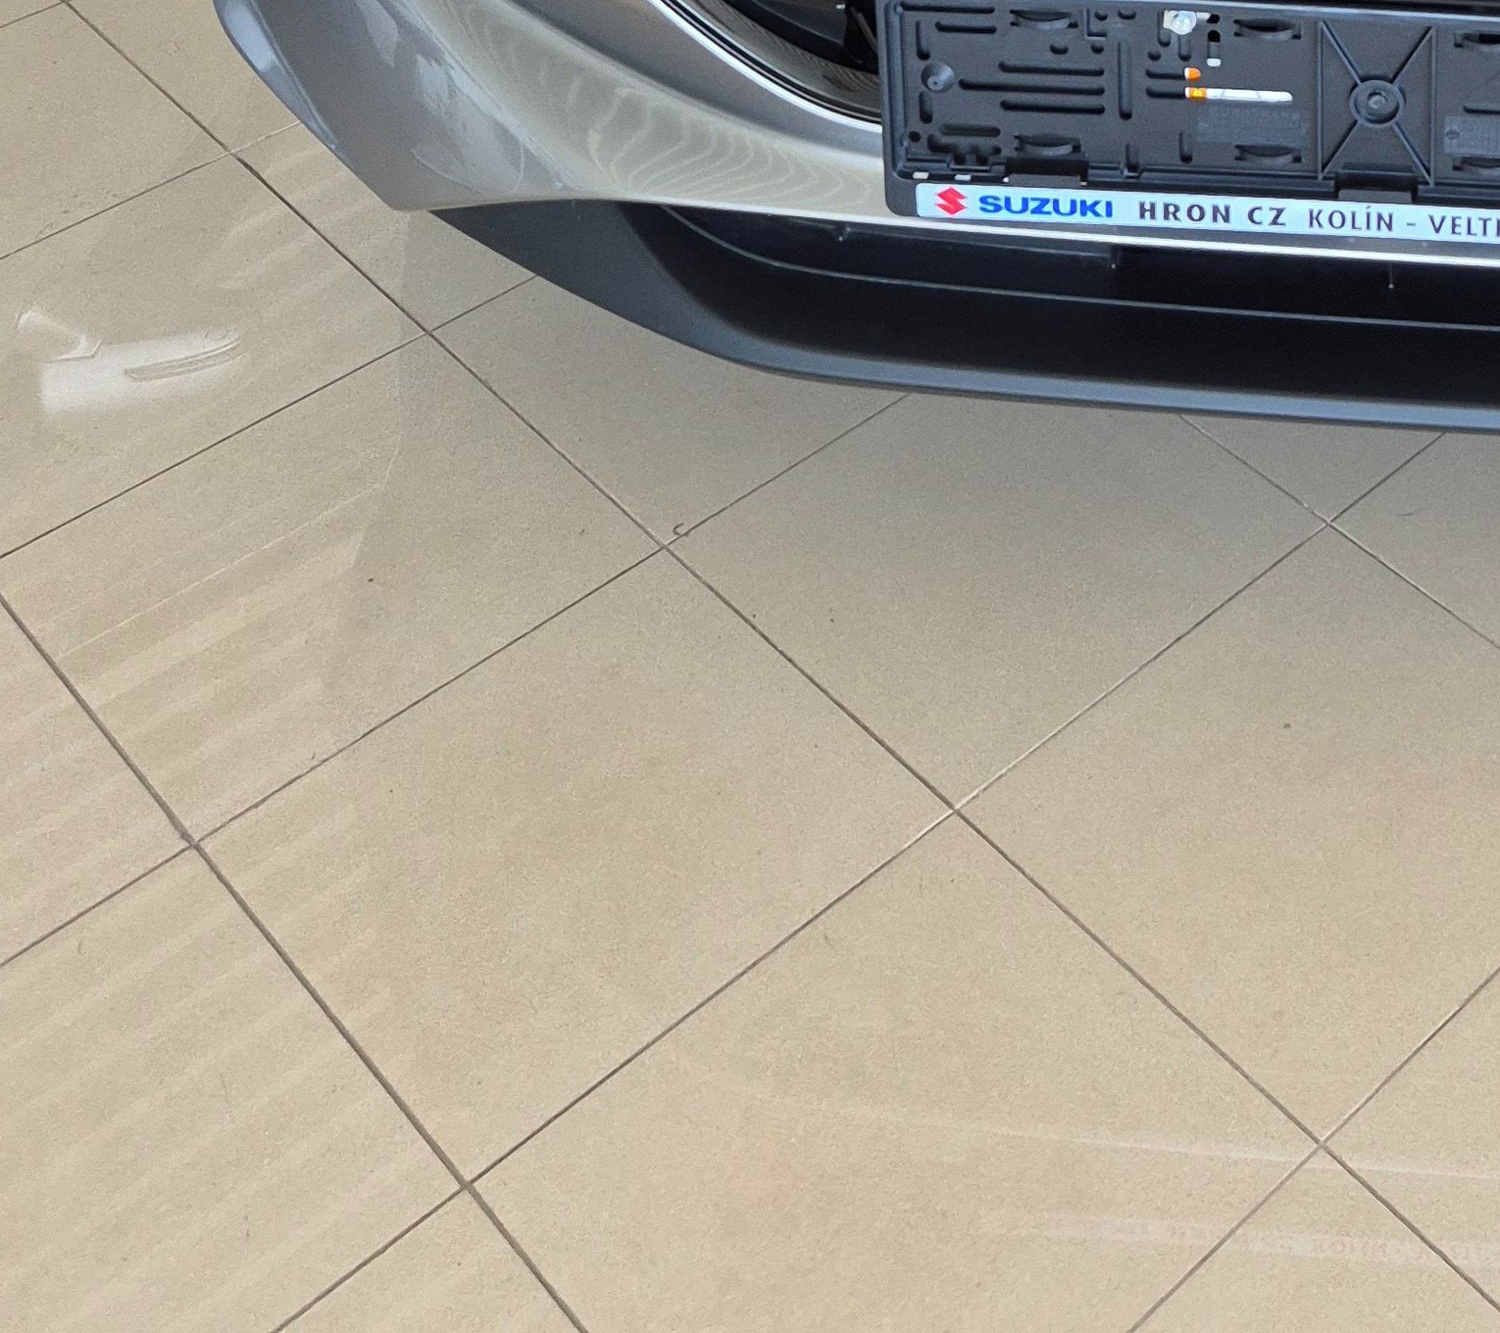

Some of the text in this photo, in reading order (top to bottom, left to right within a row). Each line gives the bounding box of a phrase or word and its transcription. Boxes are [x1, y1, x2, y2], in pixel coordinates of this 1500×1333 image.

[979, 195, 1113, 218] SUZUKI
[1138, 201, 1231, 224] HRON
[1247, 206, 1287, 227] CZ
[1308, 205, 1394, 233] KOLÍN
